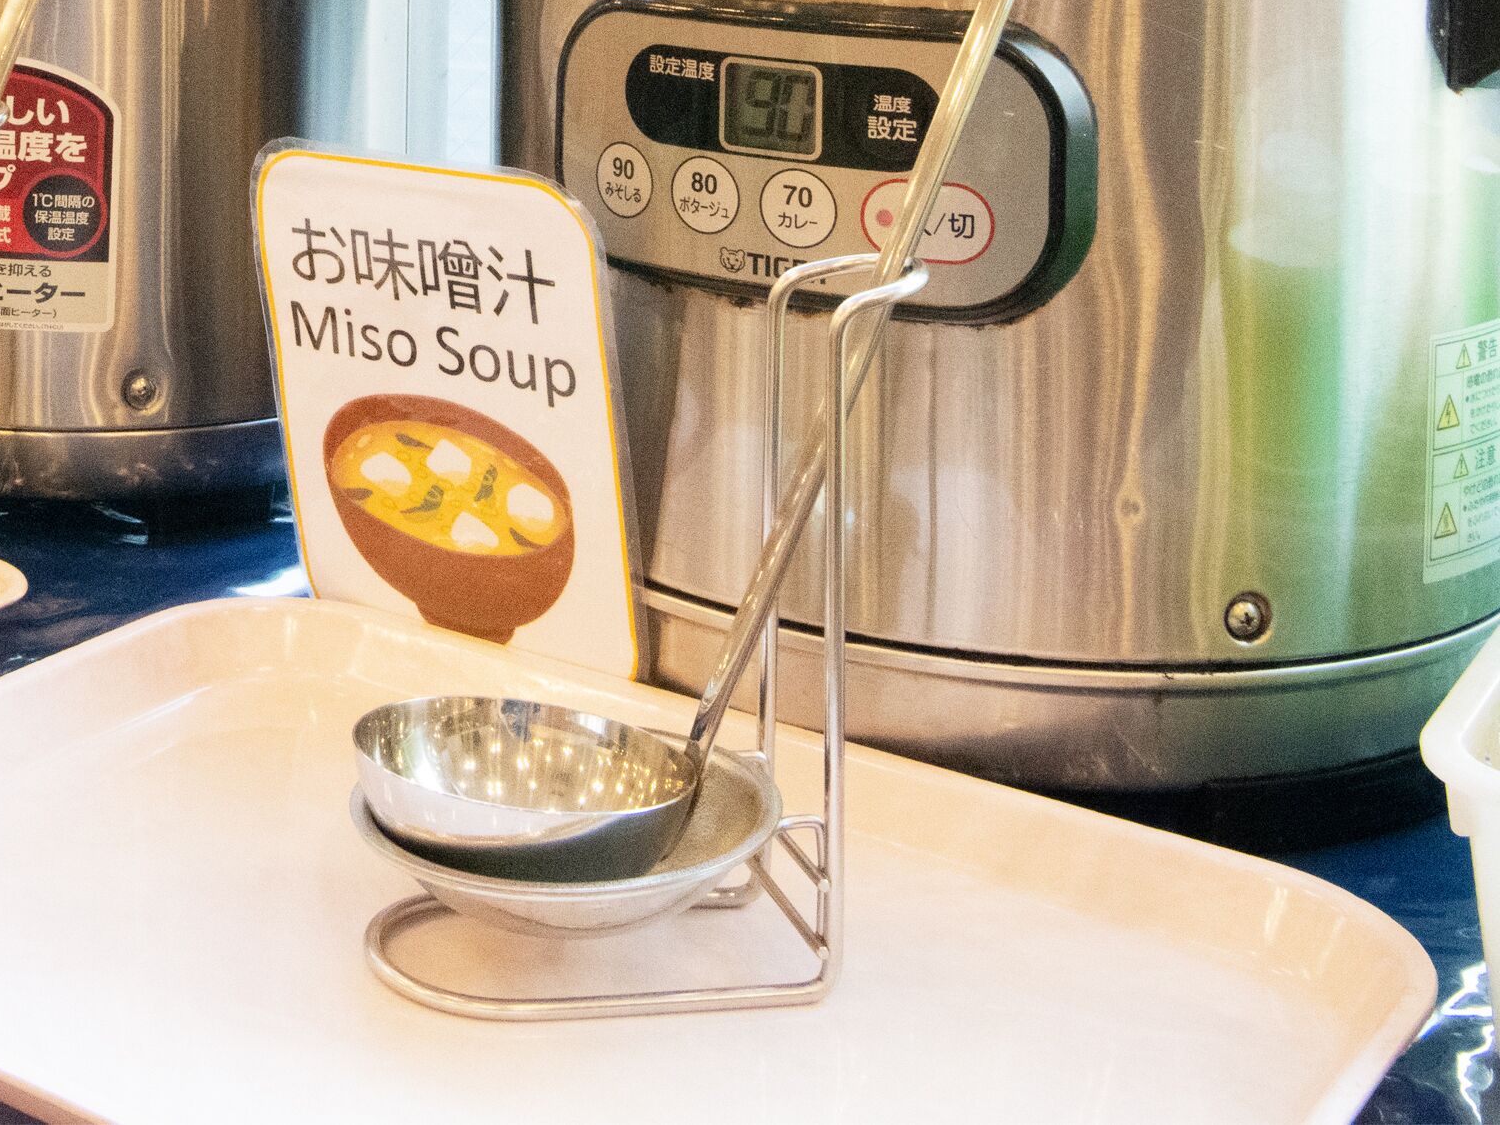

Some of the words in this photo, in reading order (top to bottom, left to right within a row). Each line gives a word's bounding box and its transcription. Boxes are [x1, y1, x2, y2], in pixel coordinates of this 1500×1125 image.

[648, 54, 715, 81] 設定温度
[873, 93, 912, 115] 温度
[867, 116, 918, 143] 設定
[612, 157, 635, 181] 90
[605, 180, 642, 204] みそしる
[691, 171, 718, 195] 80
[679, 196, 730, 220] ポタージュ
[782, 184, 813, 208] 70
[34, 209, 90, 226] 保温温度
[777, 212, 819, 231] カレー
[47, 227, 75, 242] 設定
[291, 217, 556, 325] お味噌汁
[290, 300, 418, 367] Miso
[435, 325, 577, 407] Soup
[1475, 444, 1496, 470] 注意
